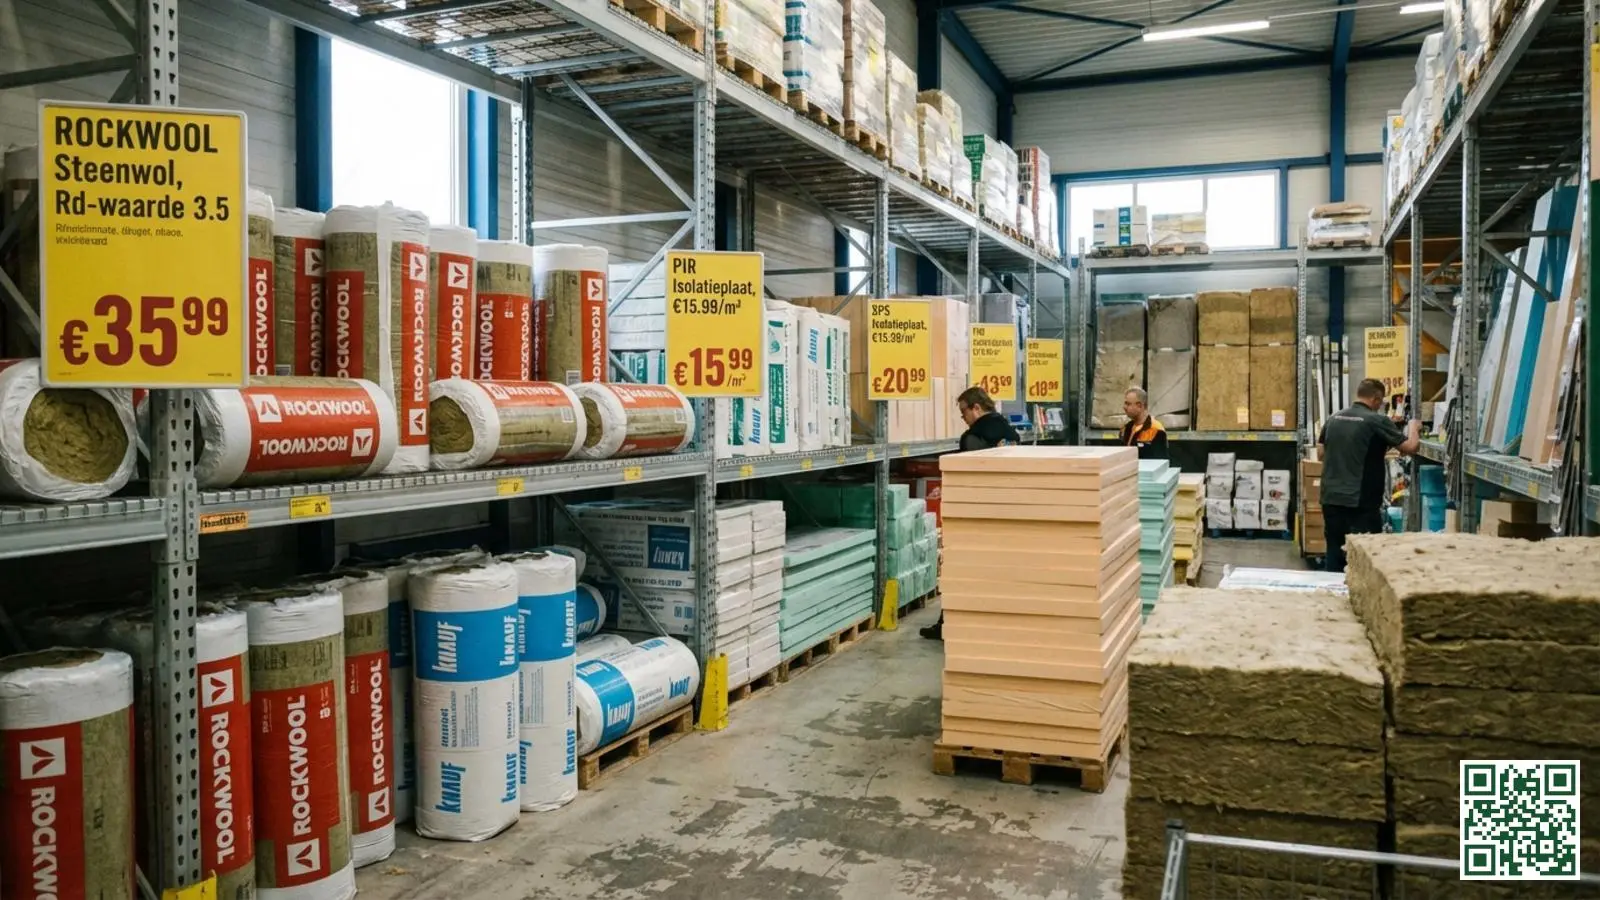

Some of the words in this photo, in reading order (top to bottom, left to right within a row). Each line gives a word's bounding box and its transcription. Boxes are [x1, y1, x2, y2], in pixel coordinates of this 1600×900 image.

[54, 115, 218, 154] ROCKWOOL
[54, 153, 183, 190] Steenwol,
[54, 190, 185, 220] Rd-waarde
[193, 196, 229, 221] 3.5
[673, 258, 696, 274] PIR
[673, 278, 756, 297] Isolatieplaat,
[255, 267, 268, 376] OCKWOOL
[336, 278, 350, 379] OCKWOOL
[479, 299, 494, 380] OCKWOOL
[283, 399, 370, 416] ROCKWOOL
[259, 435, 348, 456] ROCKWOOL
[369, 658, 385, 785] ROCKWOOL
[287, 694, 312, 836] ROCKWOOL
[210, 711, 235, 864] ROCKWOOL
